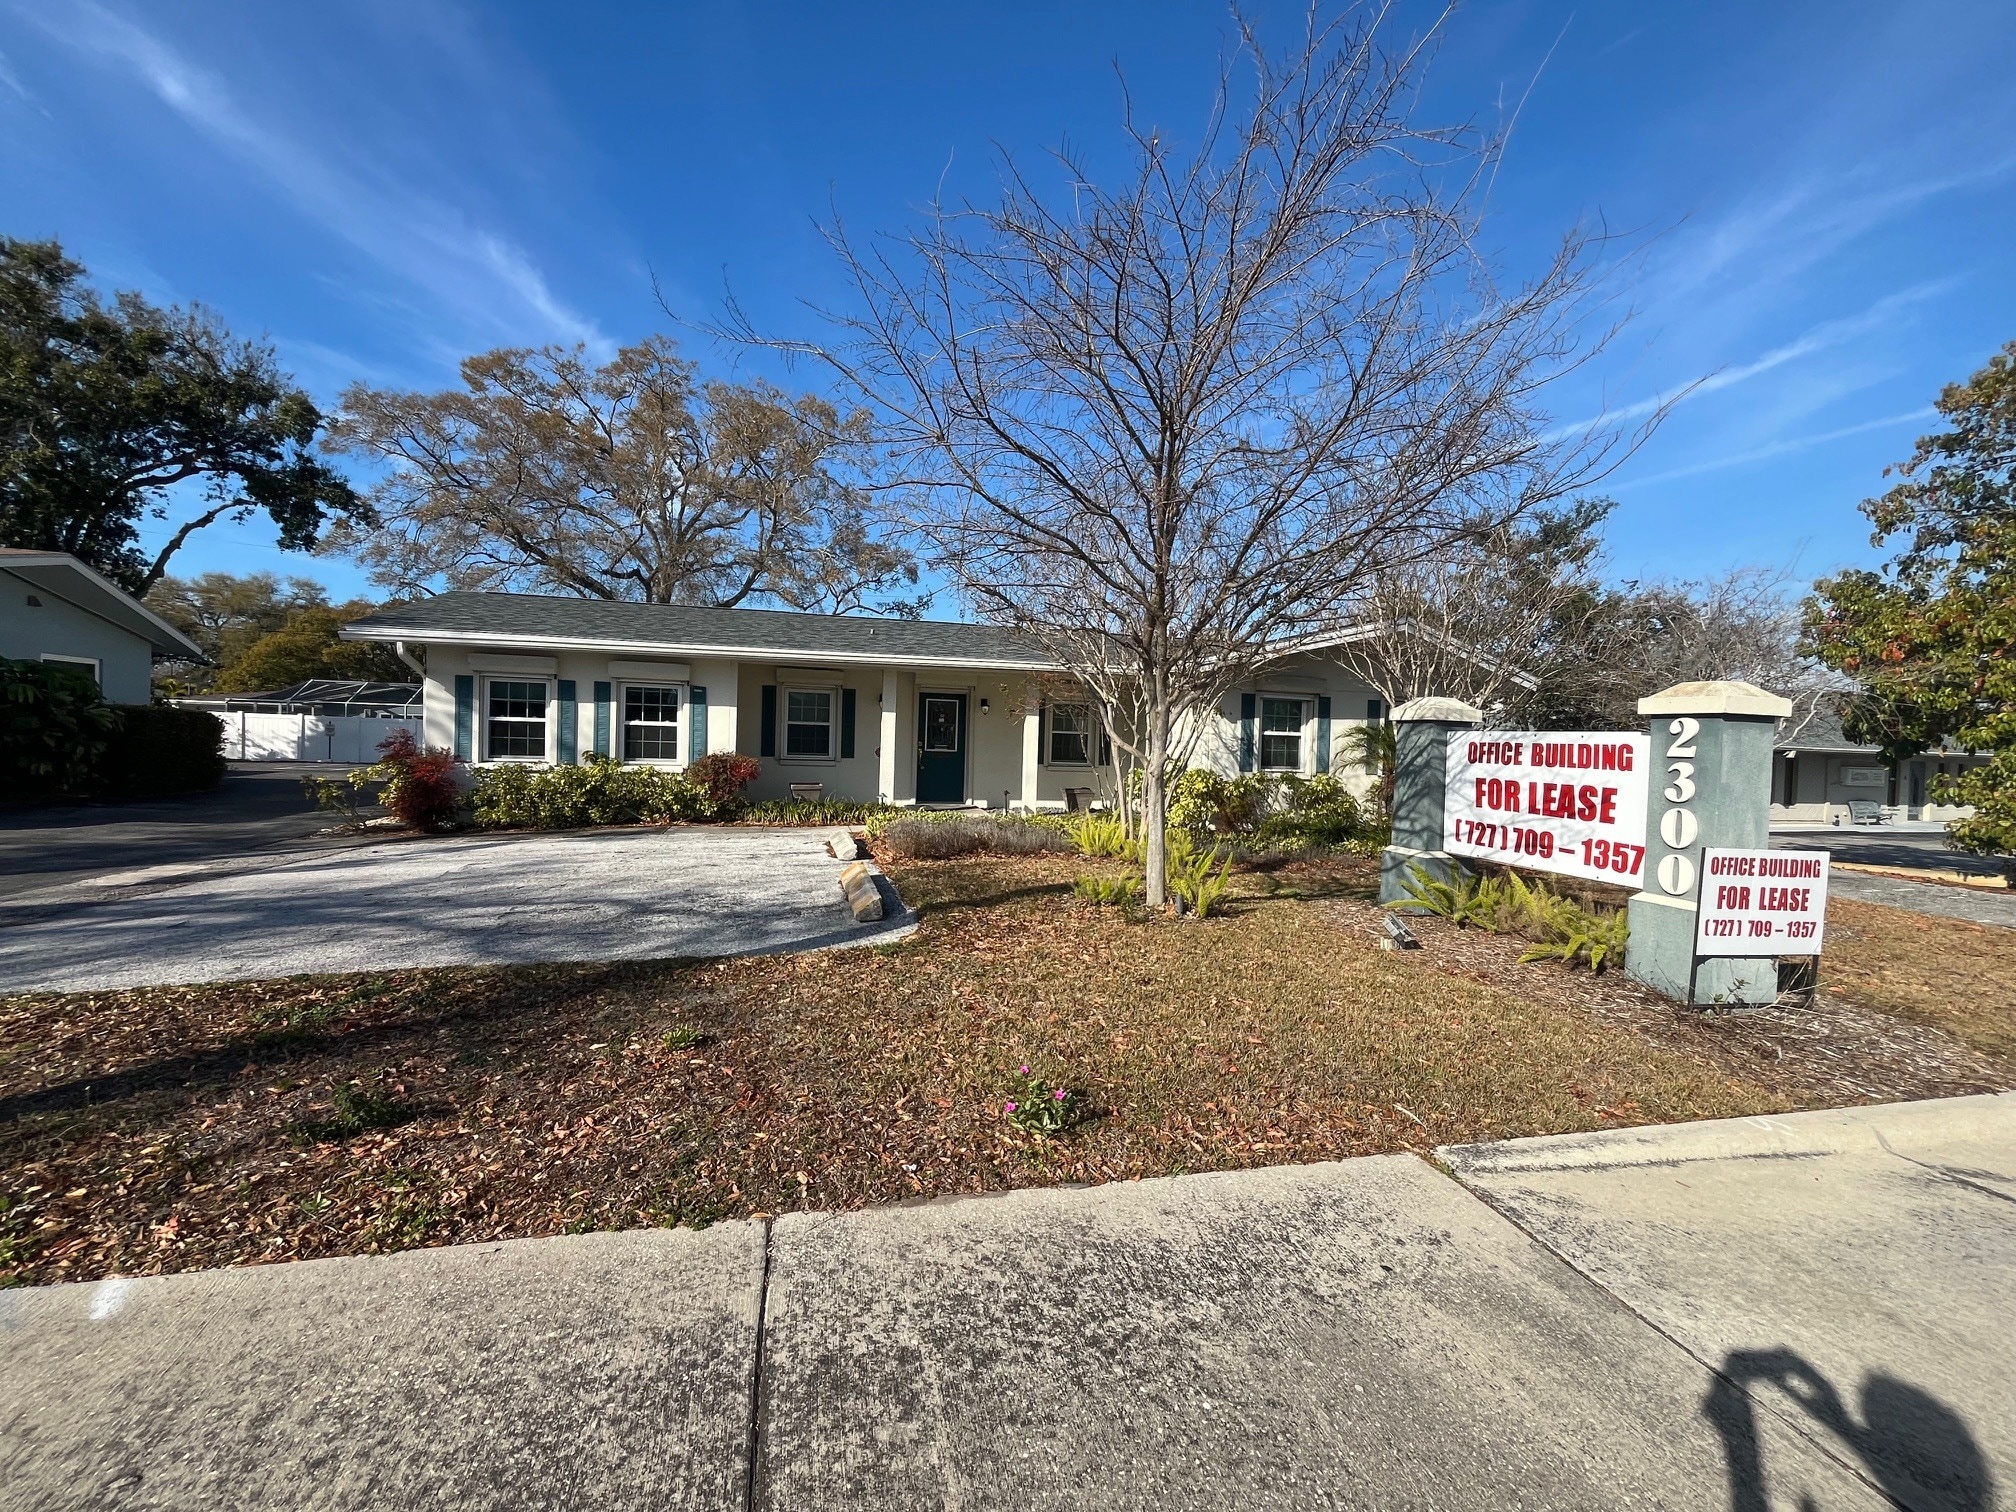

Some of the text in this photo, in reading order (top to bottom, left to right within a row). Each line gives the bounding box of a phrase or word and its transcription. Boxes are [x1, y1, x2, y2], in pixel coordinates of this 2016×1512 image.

[1468, 742, 1633, 771] OFFICE BUILDING
[1476, 778, 1617, 824] FOR LEASE
[1657, 717, 1700, 896] 2300
[1710, 857, 1821, 878] OFFICE BUILDING
[1717, 886, 1810, 912] FOR LEASE
